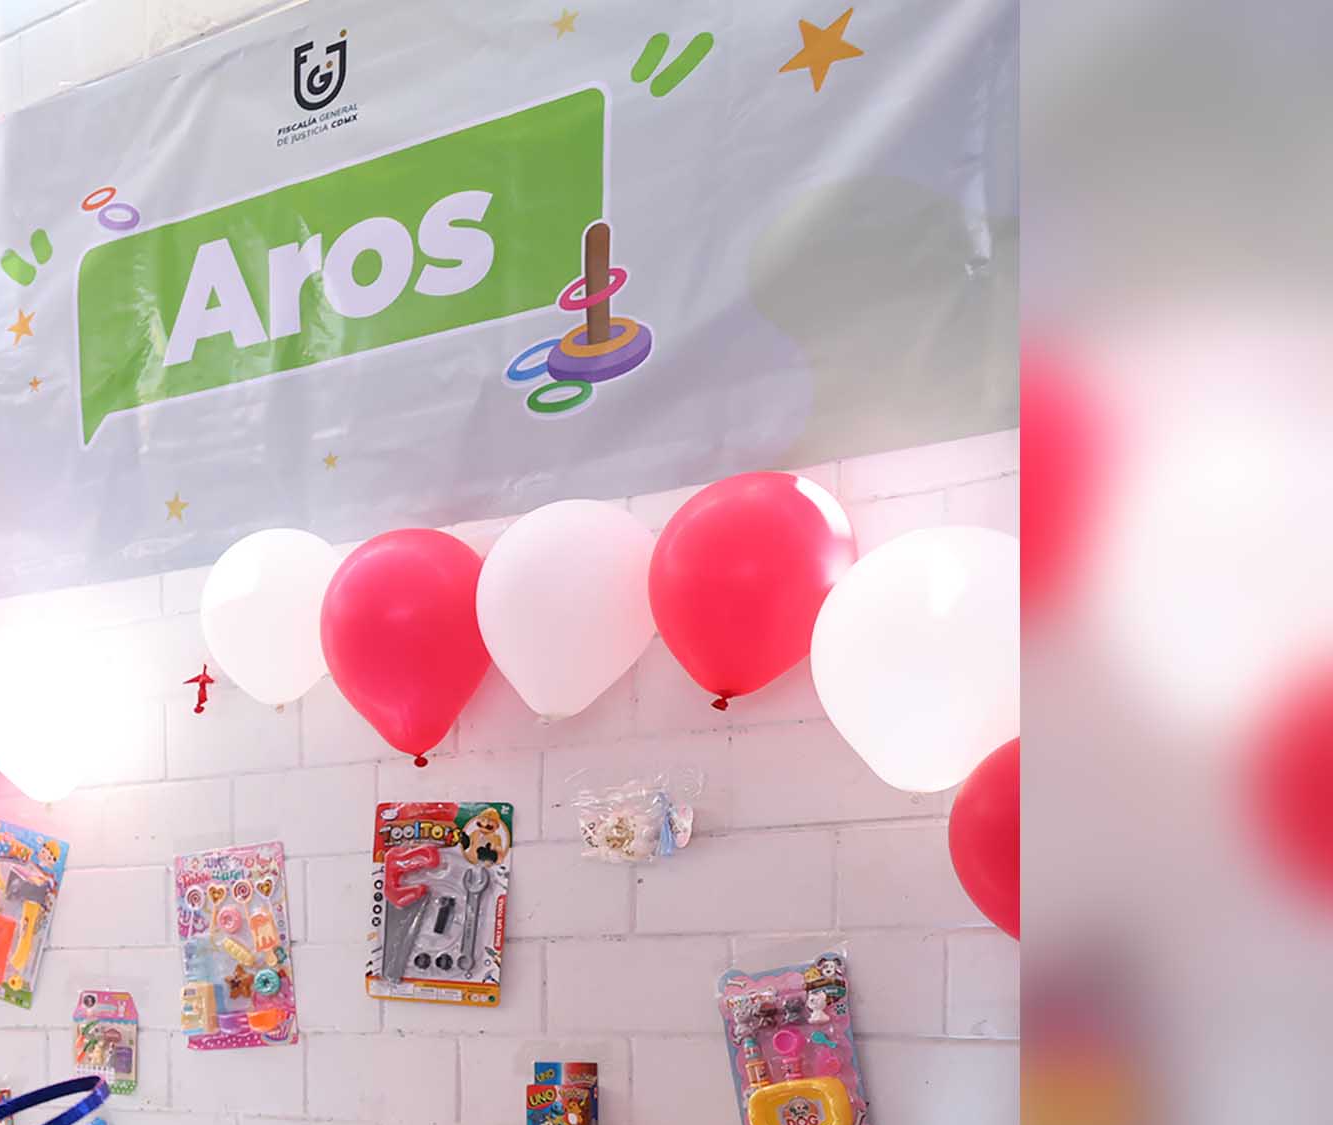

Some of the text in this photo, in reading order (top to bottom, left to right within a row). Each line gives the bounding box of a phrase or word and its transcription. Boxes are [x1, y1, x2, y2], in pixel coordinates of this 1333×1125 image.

[276, 113, 358, 147] DE JUSTICIA CDMX
[277, 103, 358, 136] FISCALÍA GENERAL
[164, 190, 494, 367] Aros
[530, 1089, 555, 1106] UNO
